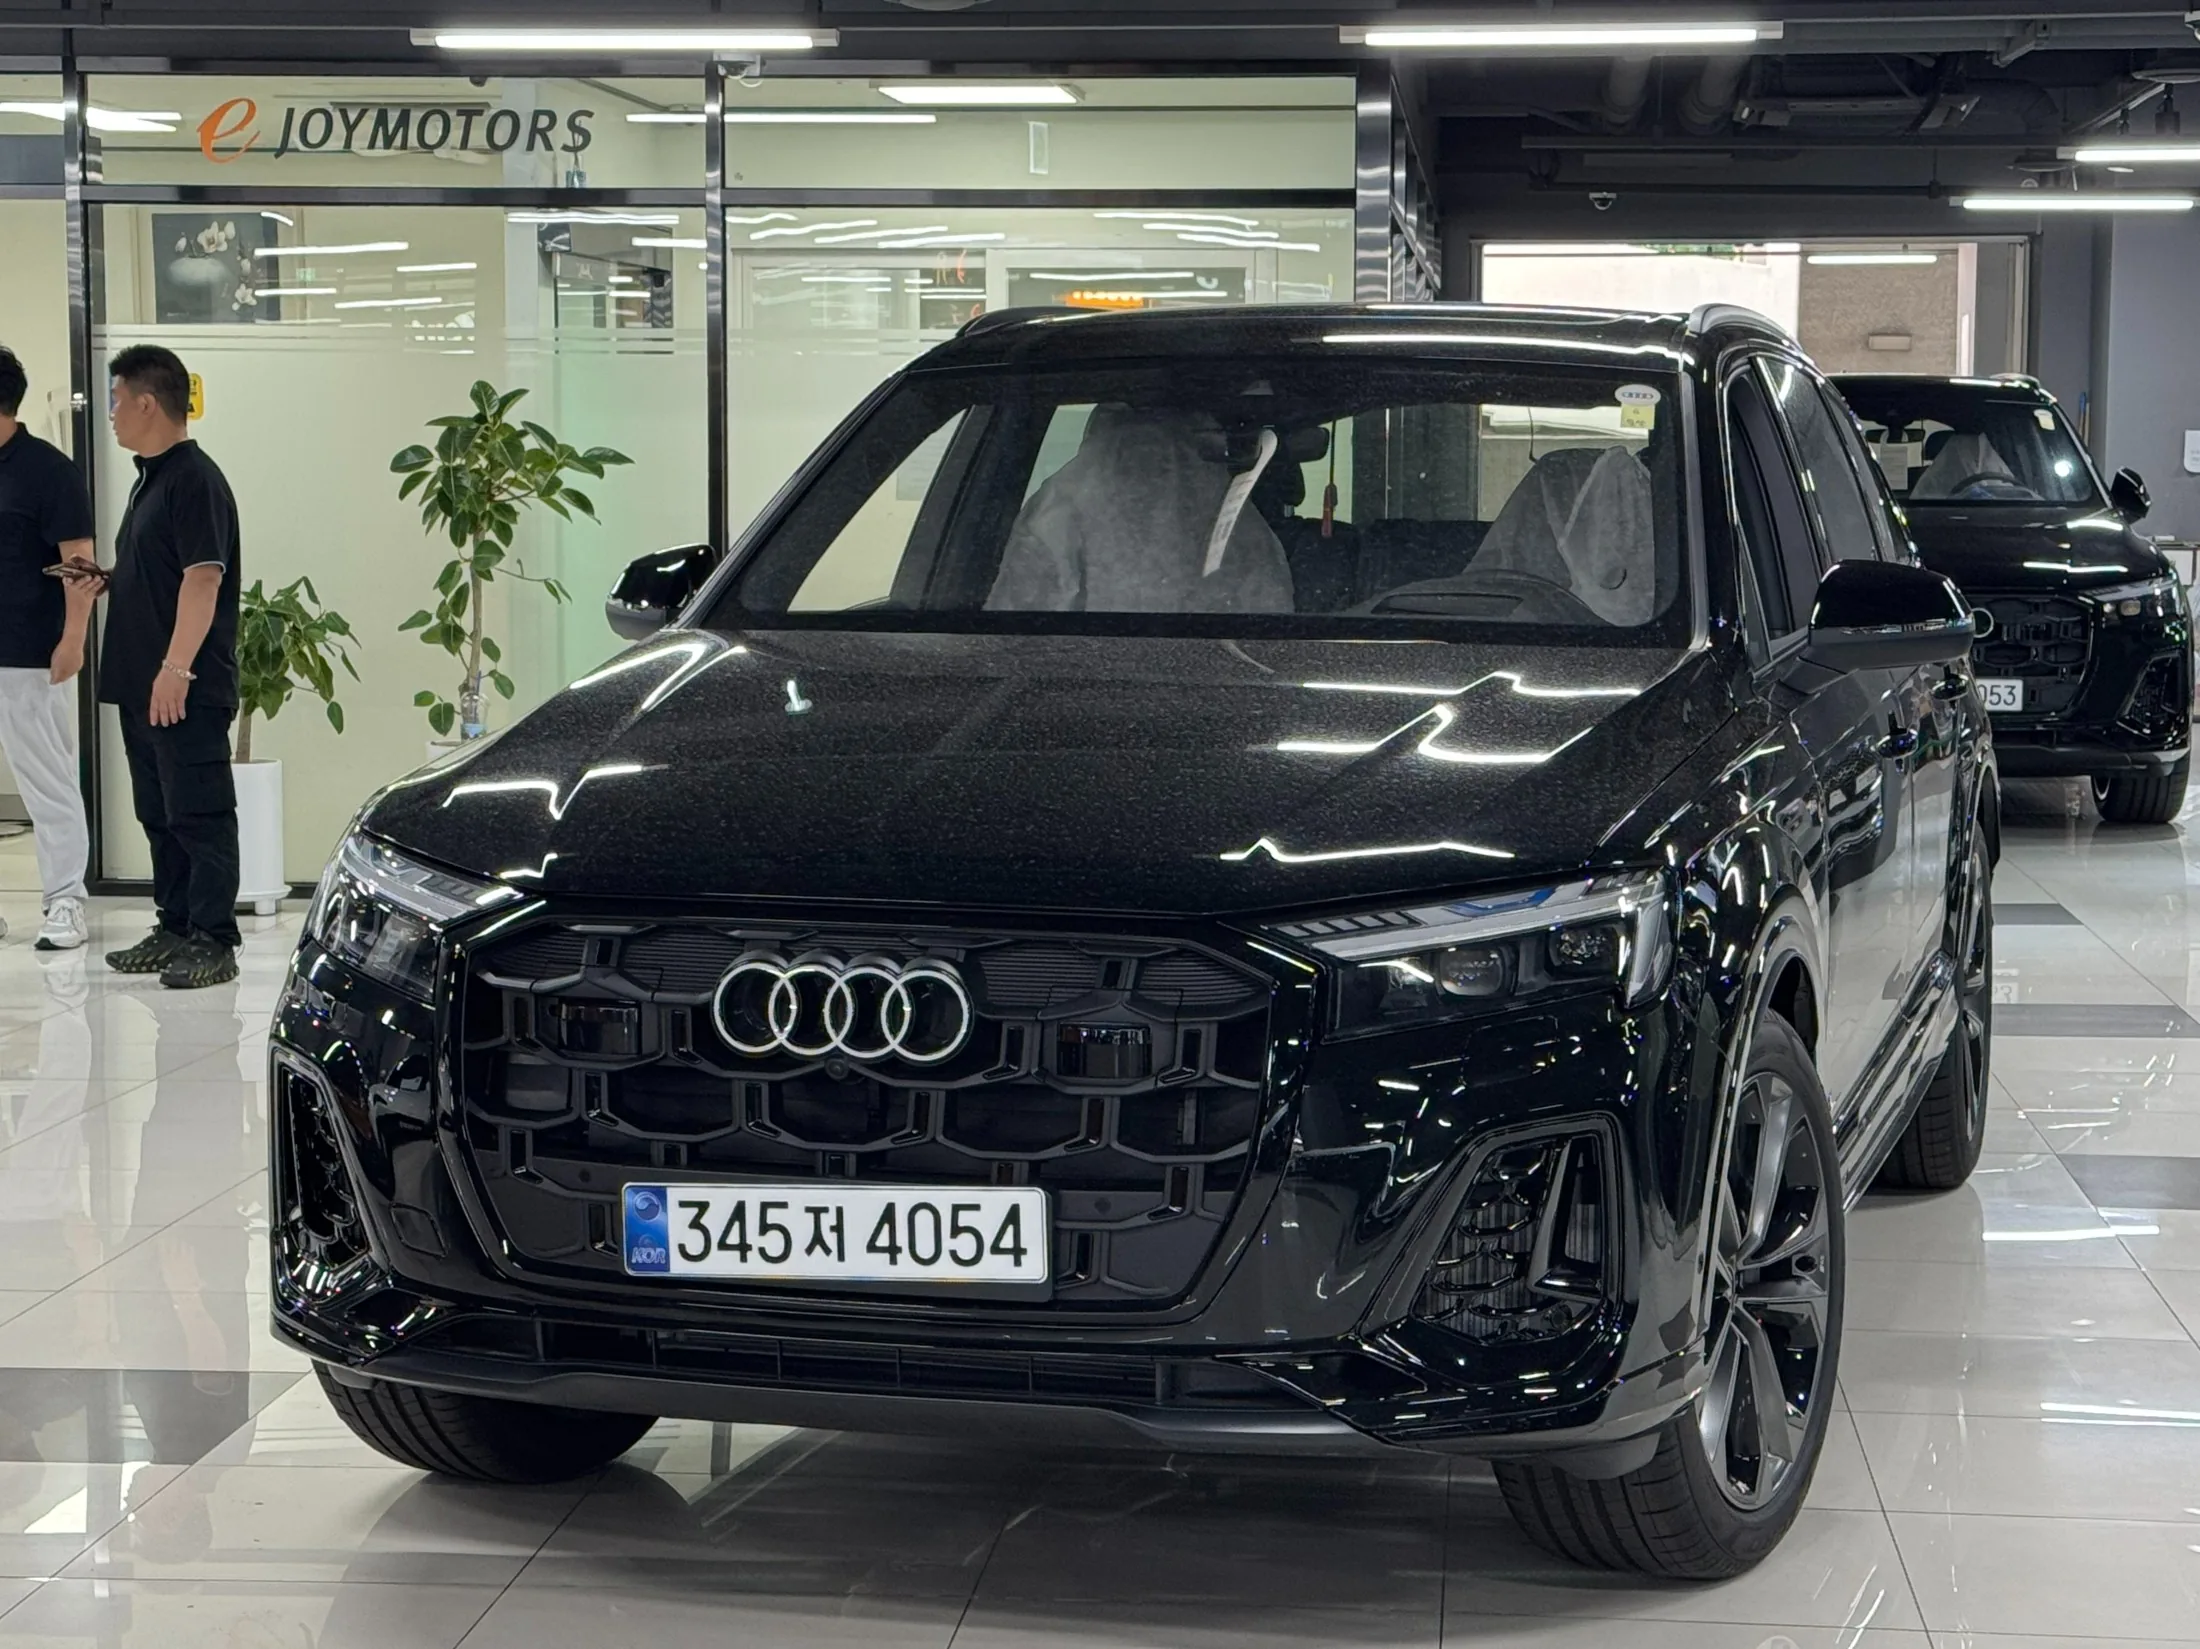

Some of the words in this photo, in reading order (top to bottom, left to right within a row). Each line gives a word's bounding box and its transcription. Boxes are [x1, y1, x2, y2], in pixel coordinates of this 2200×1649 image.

[196, 97, 261, 164] e
[274, 107, 595, 159] JOYMOTORS
[677, 1200, 846, 1264] 345저
[866, 1201, 1028, 1268] 4054
